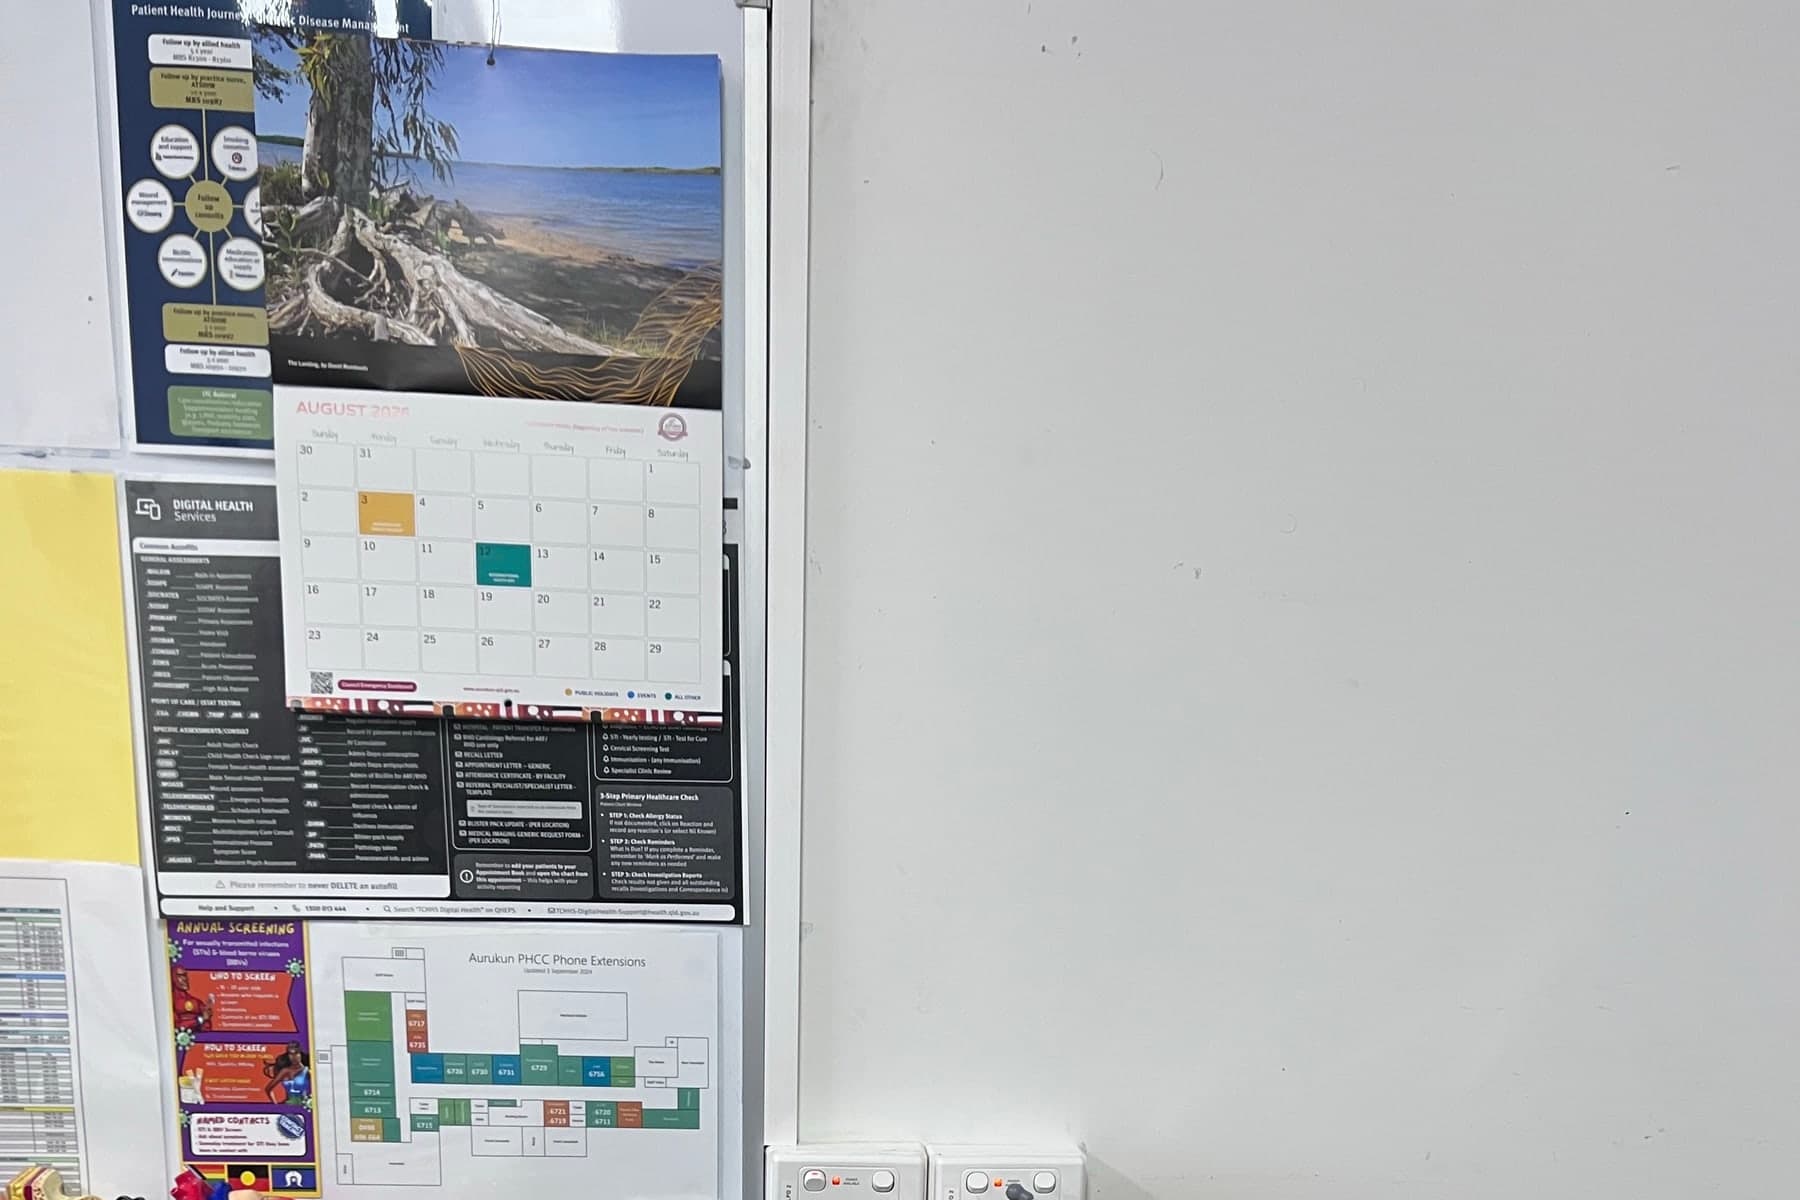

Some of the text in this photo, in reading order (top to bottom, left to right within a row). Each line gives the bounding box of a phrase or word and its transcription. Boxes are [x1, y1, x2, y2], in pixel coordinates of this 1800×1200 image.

[131, 4, 168, 17] Patient
[170, 5, 205, 18] Health
[299, 15, 340, 29] Disease
[296, 401, 367, 417] AUGUST
[299, 444, 313, 456] 30
[359, 448, 372, 459] 31
[173, 499, 253, 512] DIGITAL HEALTH
[302, 491, 655, 519] 2 3 4 5 6 7 8
[174, 511, 216, 522] Services
[304, 539, 311, 549] 9
[363, 541, 376, 551] 10
[422, 544, 433, 554] 11
[537, 549, 549, 559] 13
[593, 552, 605, 561] 14
[650, 555, 661, 565] 15
[307, 585, 661, 609] 16 17 18 19 20 21 22
[308, 630, 662, 654] 23 24 25 26 27 28 29
[600, 792, 620, 801] 3-Step
[621, 793, 645, 802] Primary
[646, 793, 679, 801] Healthcare
[330, 882, 358, 890] DELETE
[176, 921, 295, 935] ANNUAL SCREENING
[468, 952, 647, 967] Aurukun PHCC Phone Extensions
[244, 973, 276, 981] SCREEN
